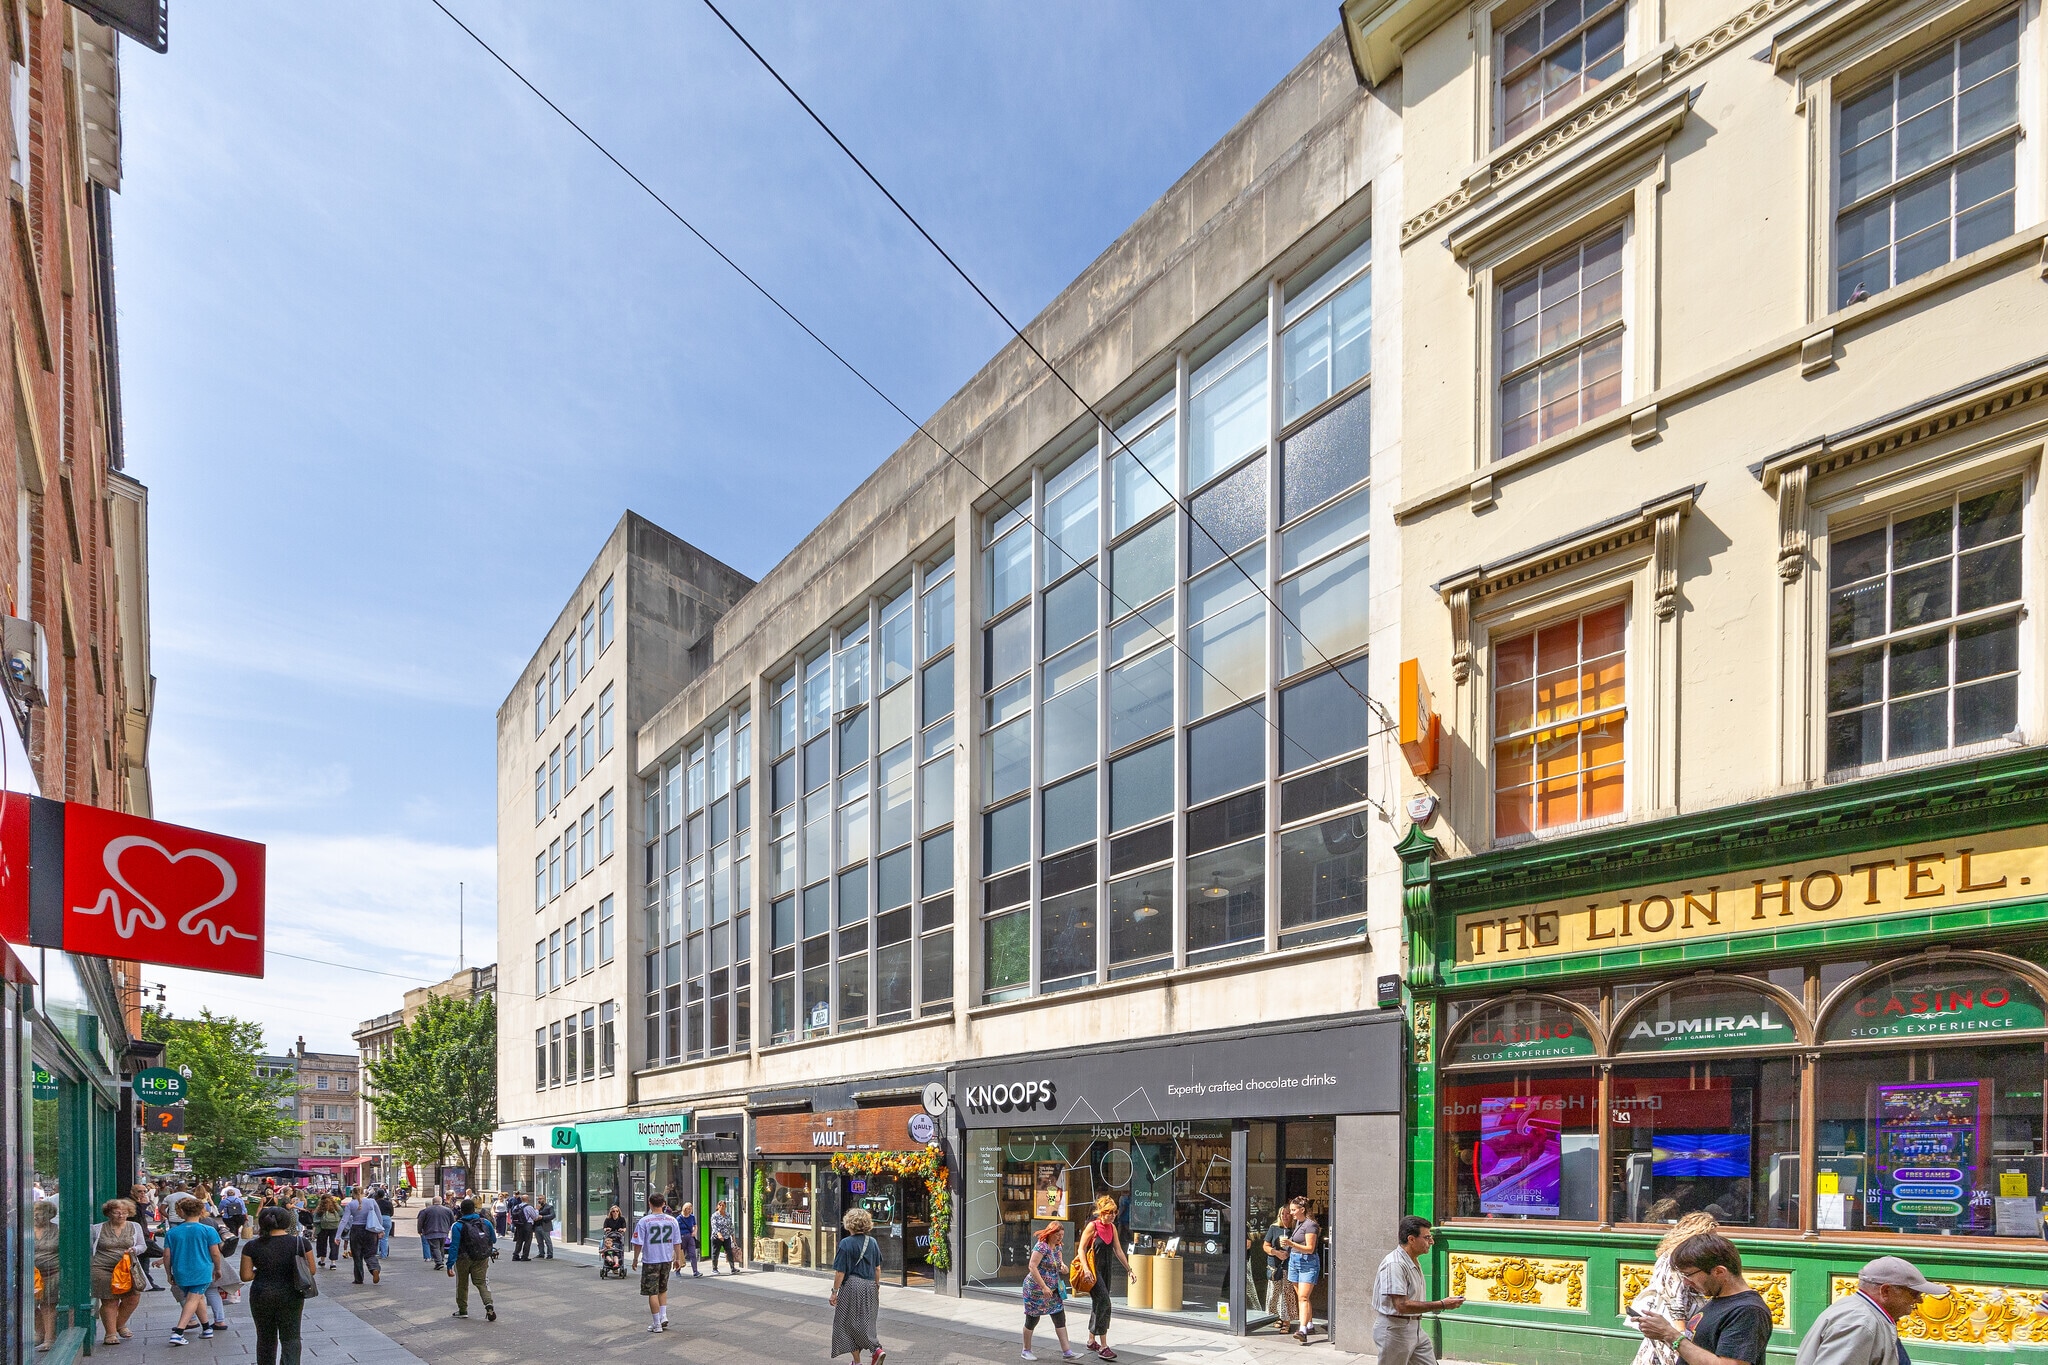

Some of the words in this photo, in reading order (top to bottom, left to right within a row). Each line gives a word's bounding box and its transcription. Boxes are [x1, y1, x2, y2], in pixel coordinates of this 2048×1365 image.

[1466, 910, 1559, 956] THE
[1586, 885, 1721, 941] LION
[1751, 848, 2031, 919] HOTEL.
[1854, 987, 2010, 1018] CASINO
[1473, 1022, 1574, 1045] CASINO
[1629, 1011, 1783, 1039] ADMIRAL
[1851, 1026, 1899, 1037] SLOTS
[1907, 1018, 2014, 1033] EXPERIENCE
[1471, 1051, 1503, 1061] SLOTS
[1507, 1046, 1576, 1059] EXPERIENCE
[141, 1077, 180, 1090] H&B
[1168, 1083, 1207, 1097] Expertly
[1208, 1079, 1244, 1093] crafted
[1245, 1076, 1299, 1090] chocolate
[1301, 1073, 1337, 1087] drinks
[966, 1079, 1051, 1108] KNOOPS
[638, 1121, 682, 1136] Nottingham
[1188, 1132, 1224, 1140] knoops.co.uk
[649, 1138, 665, 1147] Building
[813, 1131, 845, 1147] VAULT
[1153, 1189, 1159, 1197] in
[1134, 1199, 1143, 1207] for
[1144, 1199, 1163, 1208] coffee
[650, 1224, 673, 1244] 22
